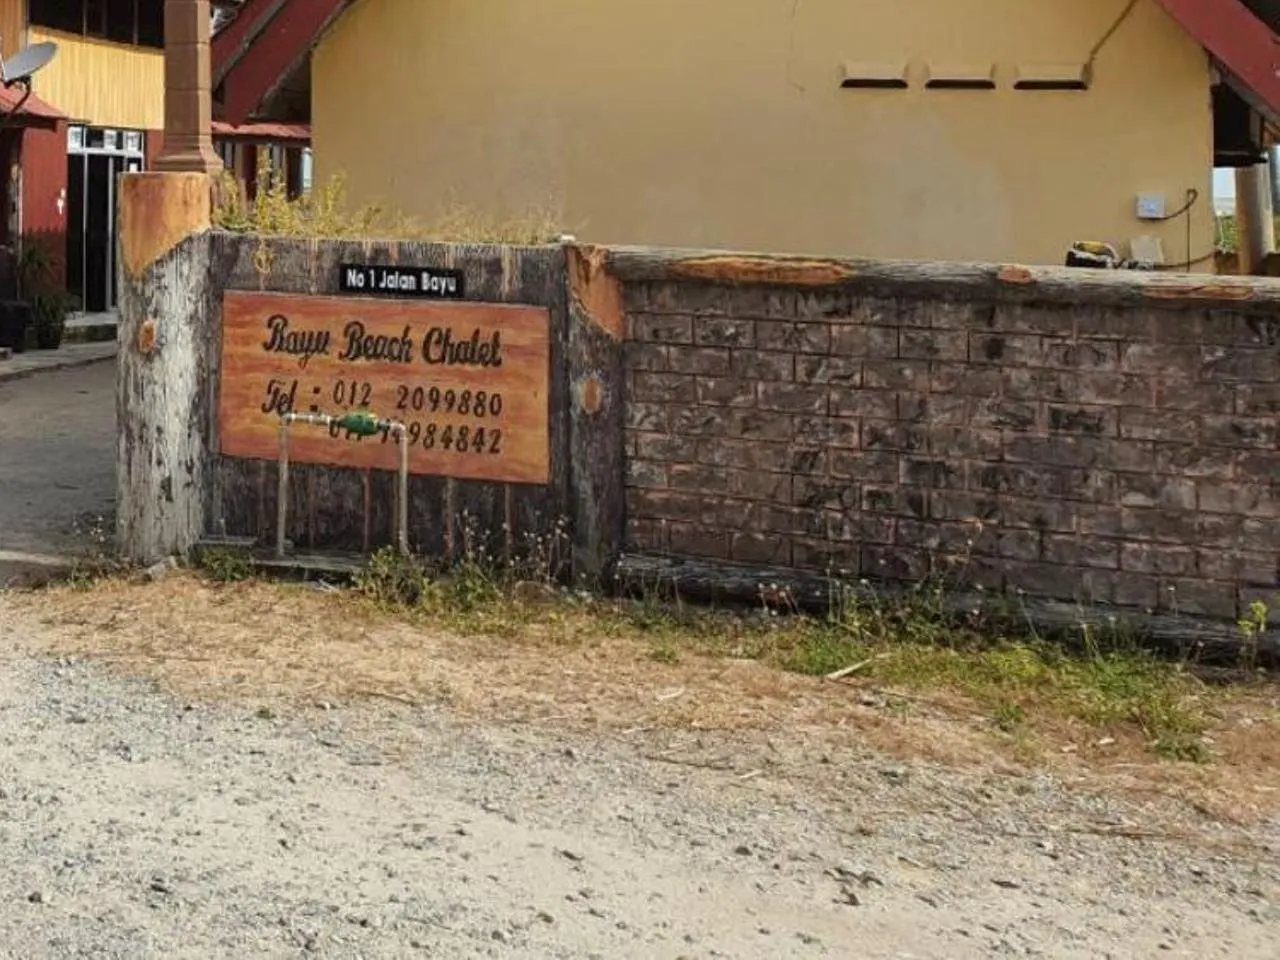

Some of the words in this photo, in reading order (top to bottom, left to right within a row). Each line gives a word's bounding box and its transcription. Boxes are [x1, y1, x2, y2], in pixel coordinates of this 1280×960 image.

[346, 268, 365, 289] No
[379, 269, 417, 291] Jalan
[421, 271, 457, 296] Bayu
[339, 320, 414, 365] Beach
[422, 326, 503, 368] Chalet
[333, 379, 372, 407] 012
[397, 384, 503, 418] 2099880
